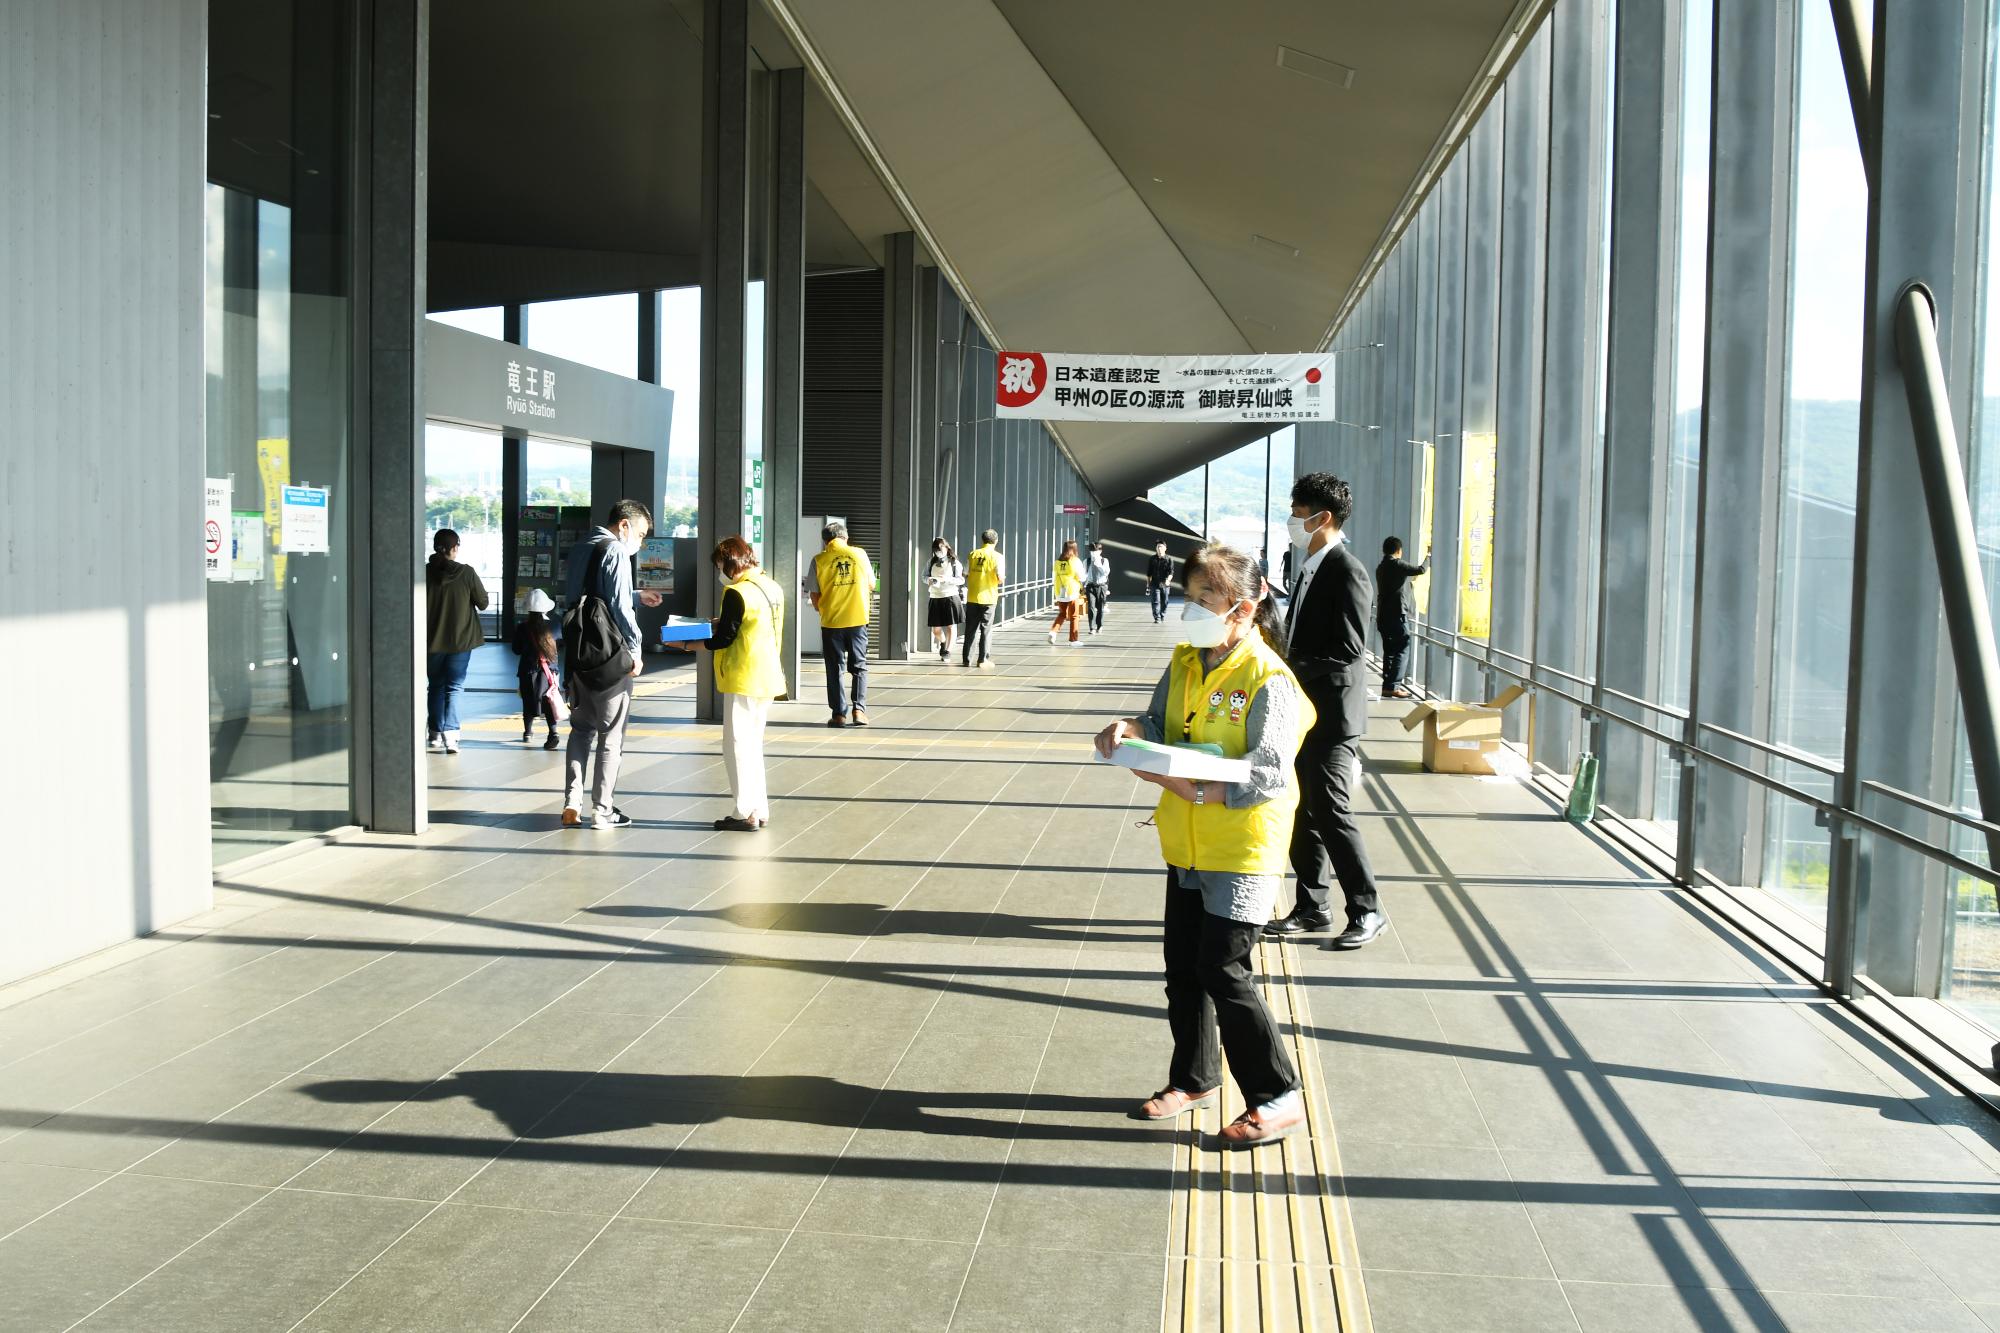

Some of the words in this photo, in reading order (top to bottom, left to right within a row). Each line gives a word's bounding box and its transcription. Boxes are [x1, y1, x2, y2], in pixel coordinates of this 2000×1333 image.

[507, 360, 556, 401] 竜王駅
[1000, 356, 1036, 394] 祝
[1055, 366, 1161, 384] 日本遺産認定
[507, 396, 527, 415] Ryūō
[529, 400, 556, 419] Station
[1055, 387, 1185, 409] 甲州の匠の源流
[1198, 388, 1293, 409] 御嶽昇仙峡
[1468, 510, 1485, 593] 人権の世紀
